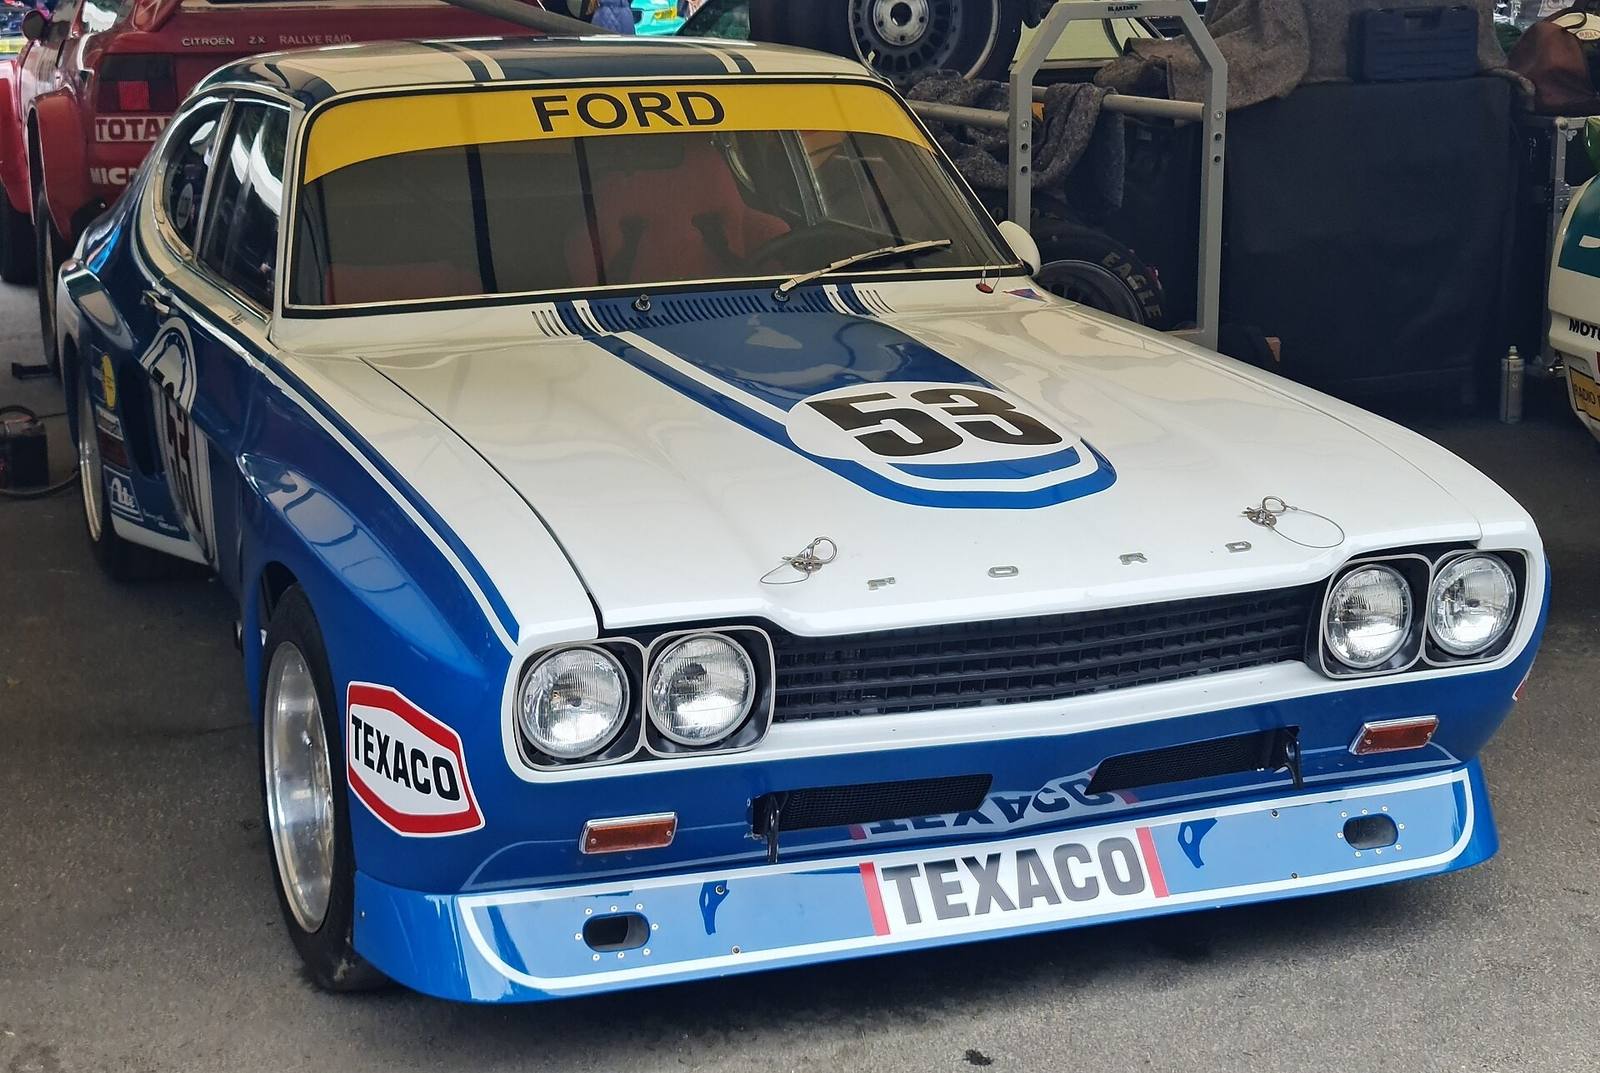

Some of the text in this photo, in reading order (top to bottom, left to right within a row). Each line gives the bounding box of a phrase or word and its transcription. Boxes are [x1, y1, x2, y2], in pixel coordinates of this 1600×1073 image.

[280, 35, 321, 44] RALLYE
[325, 34, 351, 43] RAID
[96, 118, 171, 140] TOTA
[531, 91, 725, 132] FORD
[1103, 252, 1162, 318] EAGLE
[805, 388, 1063, 456] 53
[351, 714, 460, 801] TEXACO
[880, 836, 1146, 925] TEXACO
